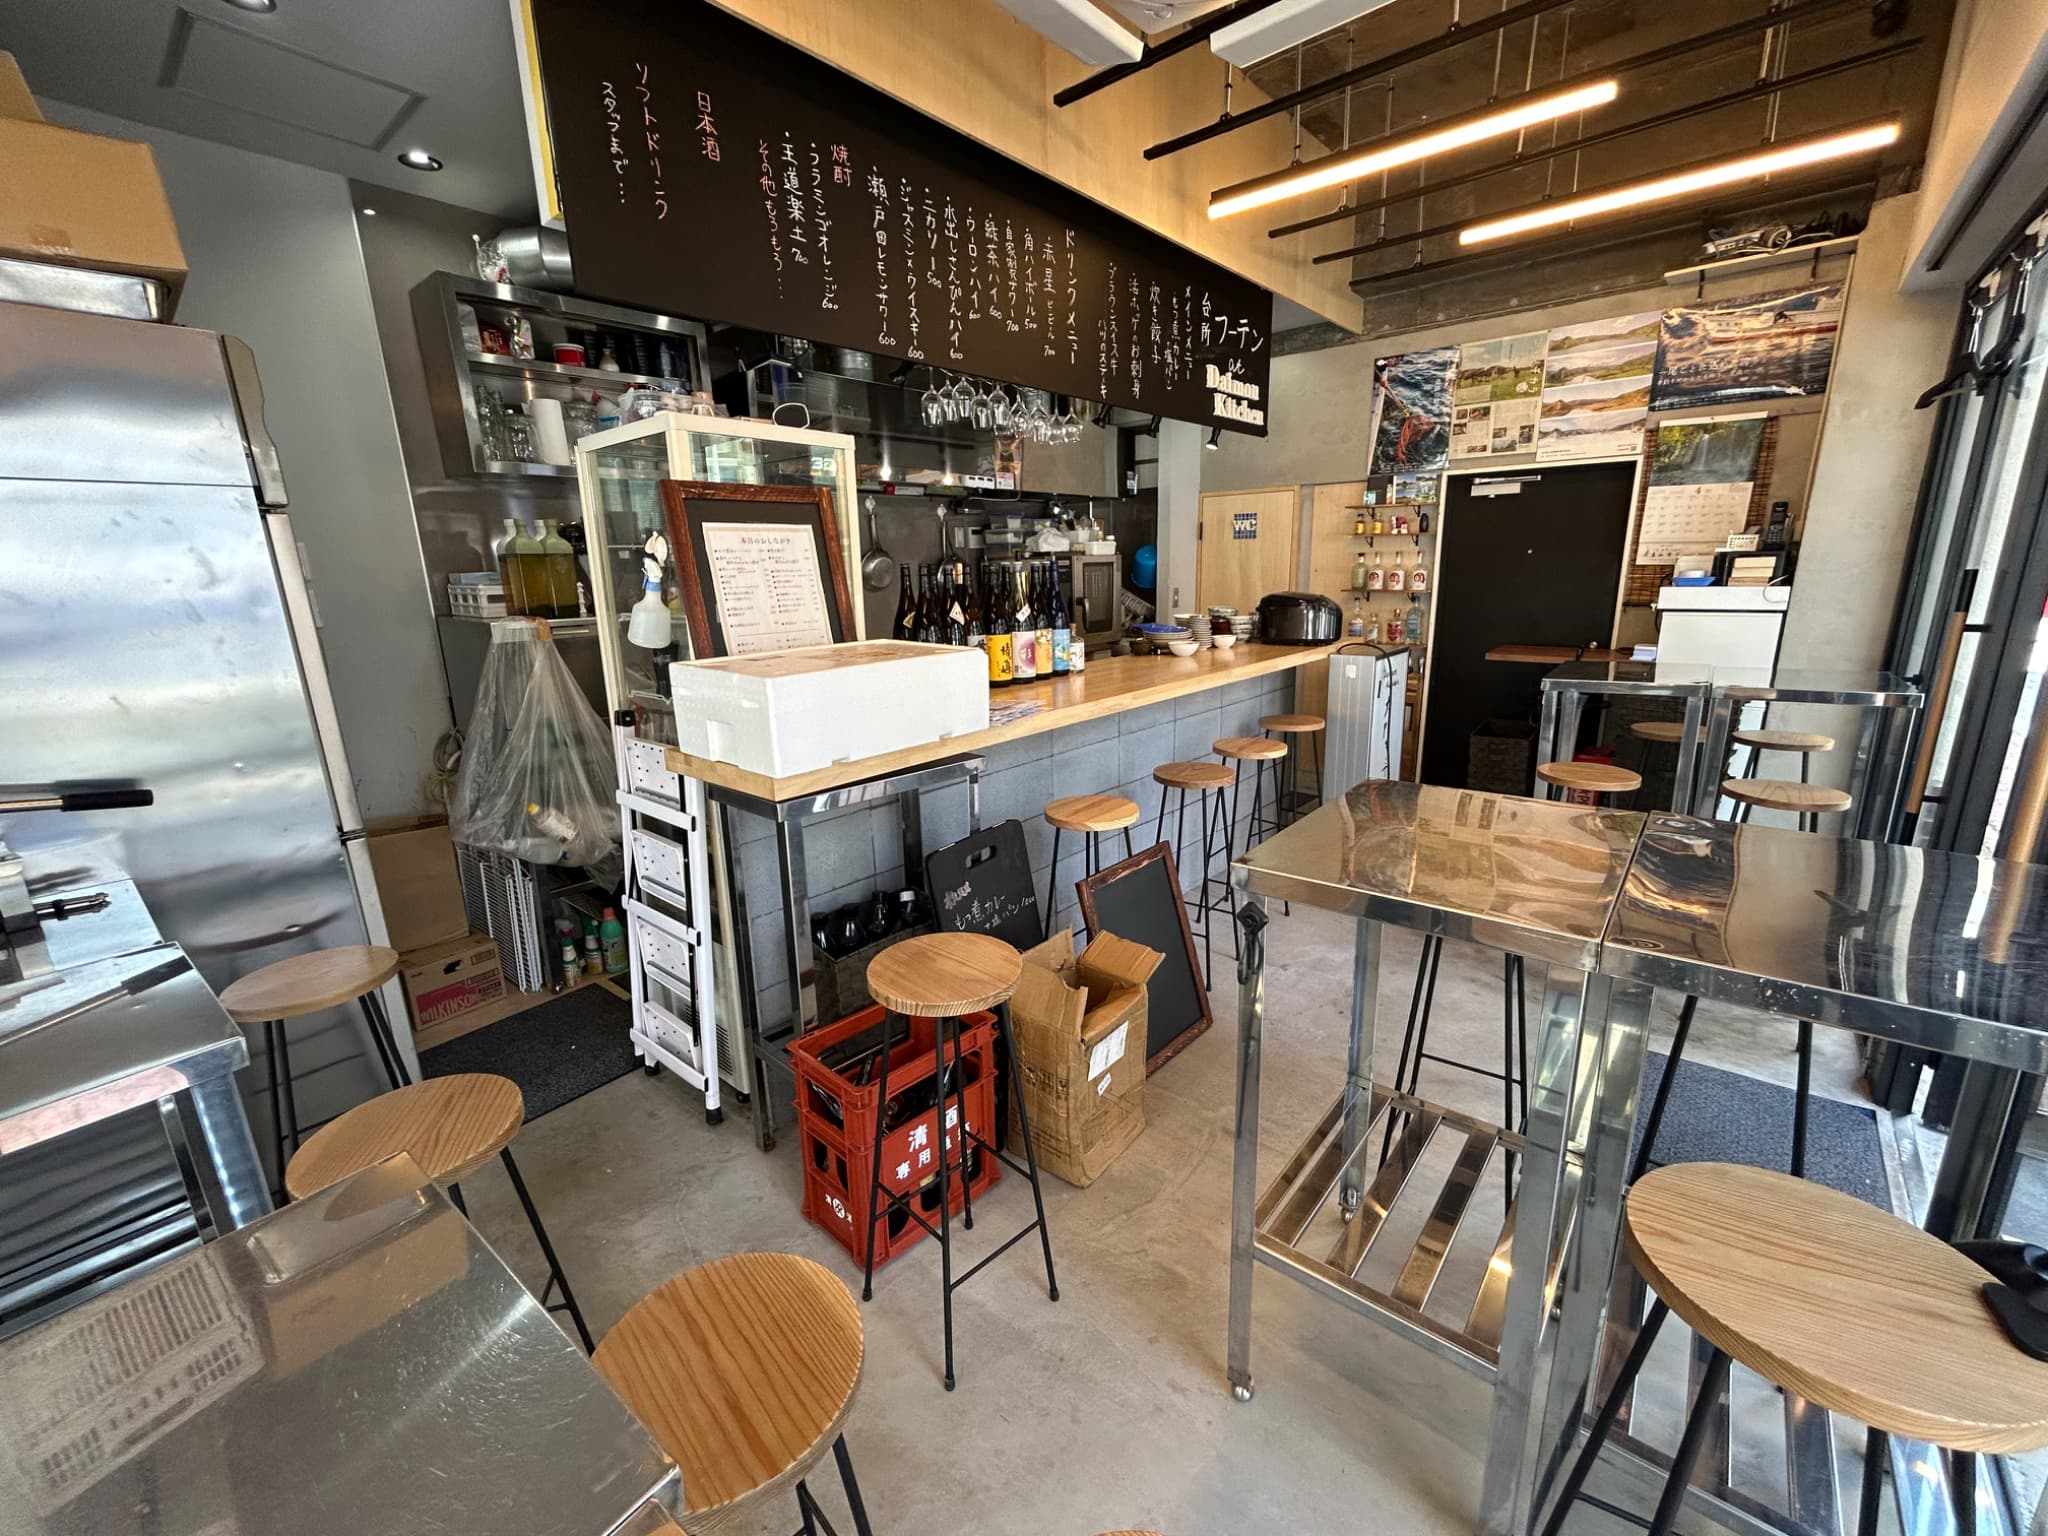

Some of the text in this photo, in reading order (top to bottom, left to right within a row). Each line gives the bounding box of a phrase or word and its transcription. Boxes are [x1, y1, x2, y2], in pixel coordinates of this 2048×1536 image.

[695, 90, 721, 162] 日本酒
[830, 143, 853, 188] 焼酎
[966, 216, 982, 309] ウーロンハイ
[985, 219, 1003, 320] 緑茶ハイ 600
[1066, 228, 1078, 365] ドリンクメニュー
[1006, 319, 1019, 332] 700
[1184, 285, 1193, 381] メインメニュー
[1201, 292, 1212, 347] 台所
[1215, 315, 1264, 352] フーテン
[878, 333, 896, 346] 600
[907, 347, 924, 360] 600
[950, 348, 963, 360] 600
[1205, 364, 1260, 401] Daimon
[1212, 392, 1265, 426] Kitchen
[1232, 519, 1257, 531] WC
